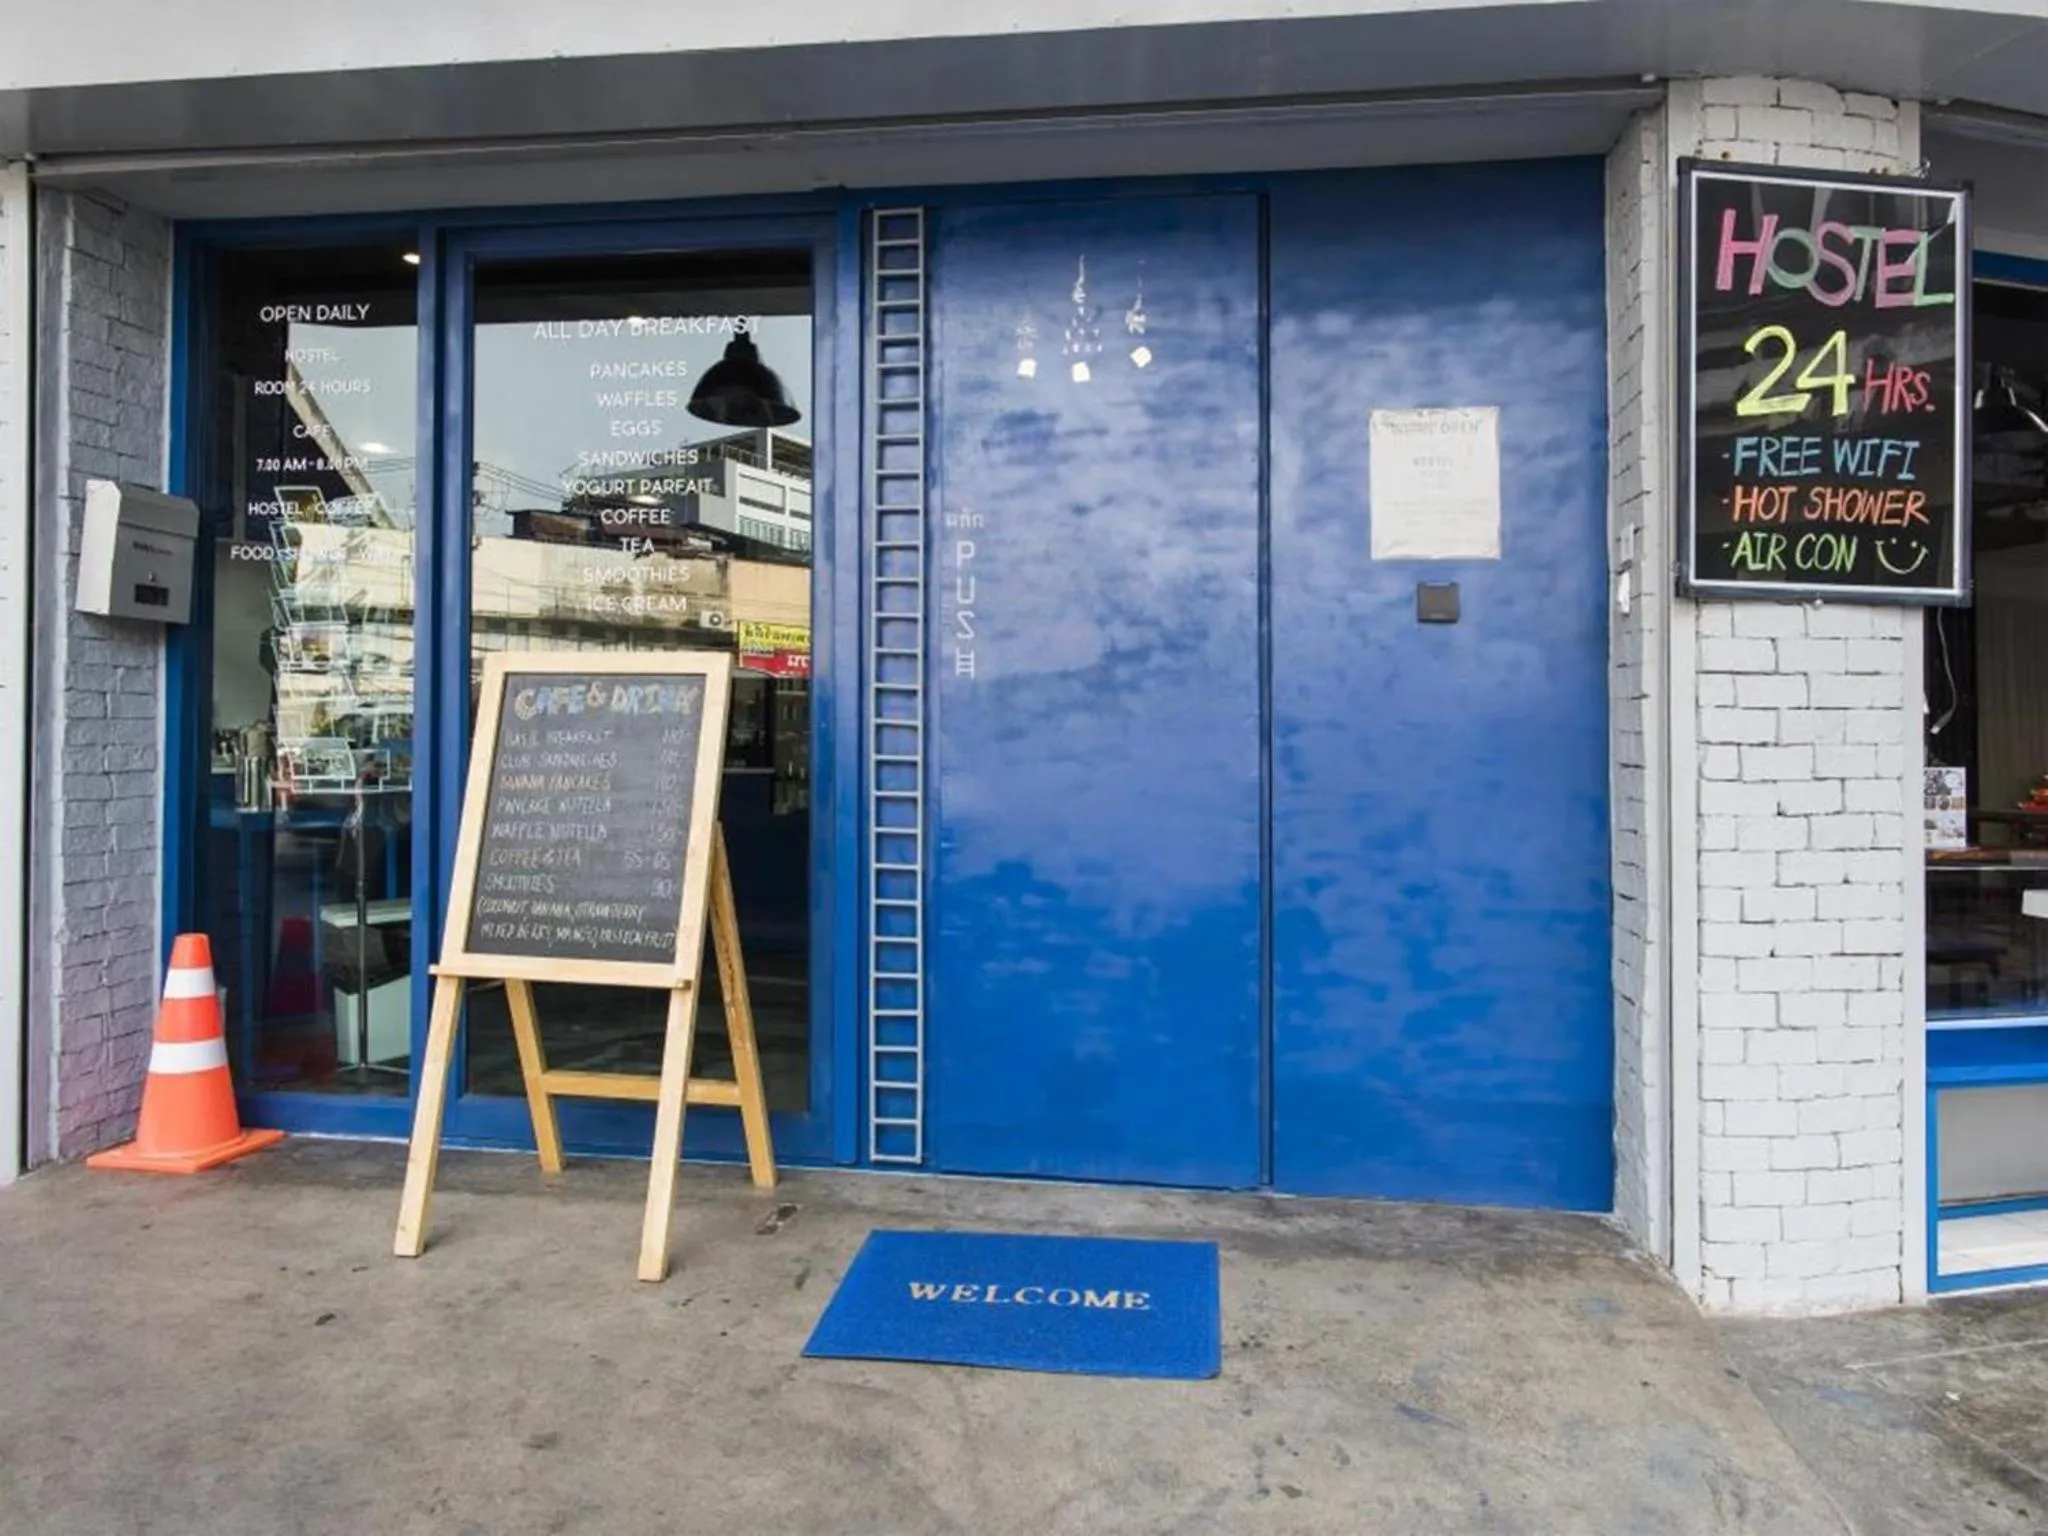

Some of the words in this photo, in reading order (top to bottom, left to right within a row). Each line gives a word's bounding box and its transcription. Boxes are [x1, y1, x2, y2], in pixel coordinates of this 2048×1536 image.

[1715, 207, 1955, 308] HOSTEL
[260, 305, 310, 322] OPEN
[316, 303, 370, 321] DAILY
[533, 321, 571, 340] ALL
[578, 319, 622, 338] DAY
[631, 315, 762, 335] BREAKFAST
[590, 361, 687, 379] PANCAKES
[1735, 324, 1856, 417] 24
[1862, 357, 1936, 415] HRS.
[254, 381, 296, 395] ROOM
[320, 380, 371, 394] HOURS
[596, 392, 677, 408] WAFFLES
[610, 420, 662, 437] EGGS
[283, 457, 306, 471] AM
[577, 449, 699, 466] SANDWICHES
[1734, 436, 1822, 478] FREE
[1833, 437, 1920, 481] WIFI
[562, 479, 637, 496] YOGURT
[641, 478, 713, 495] PARFAIT
[248, 501, 303, 516] HOSTEL
[1732, 484, 1799, 523] HOT
[1804, 485, 1929, 529] SHOWER
[601, 508, 671, 526] COFFEE
[230, 545, 275, 560] FOOD
[620, 537, 655, 553] TEA
[1731, 531, 1787, 573] AIR
[1795, 532, 1858, 573] CON
[583, 565, 690, 583] SMOOTHIES
[588, 596, 615, 612] ICE
[621, 595, 687, 613] CREAM
[955, 540, 975, 680] PUSH
[515, 684, 587, 720] CAFE
[908, 1281, 1150, 1310] WELCOME
